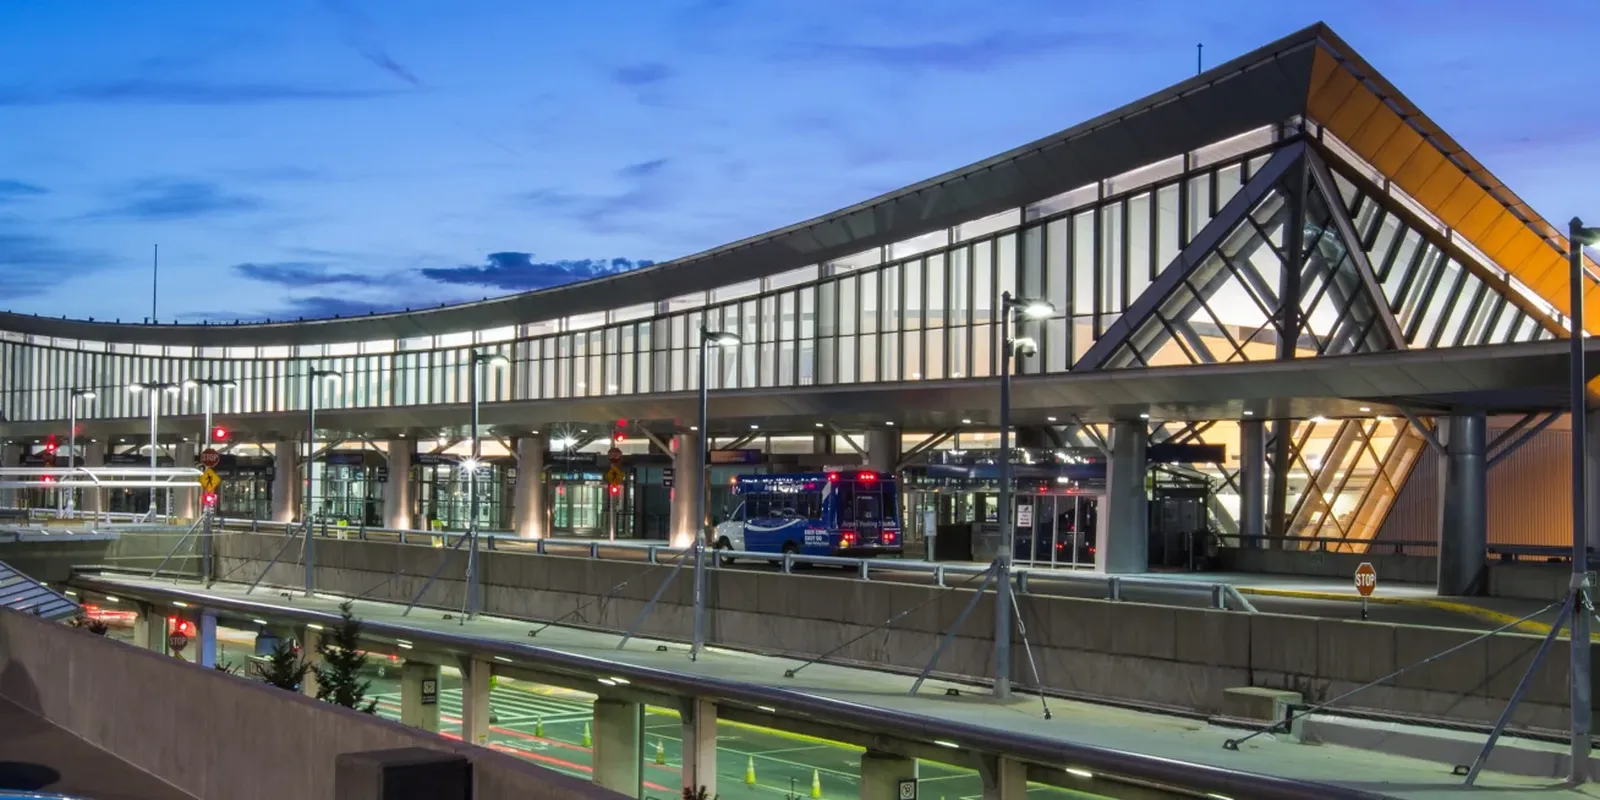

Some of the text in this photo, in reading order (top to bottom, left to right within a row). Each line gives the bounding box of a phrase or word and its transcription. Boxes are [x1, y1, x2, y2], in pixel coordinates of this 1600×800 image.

[200, 453, 219, 462] STOP
[1356, 573, 1374, 587] STOP
[169, 637, 187, 646] STOP
